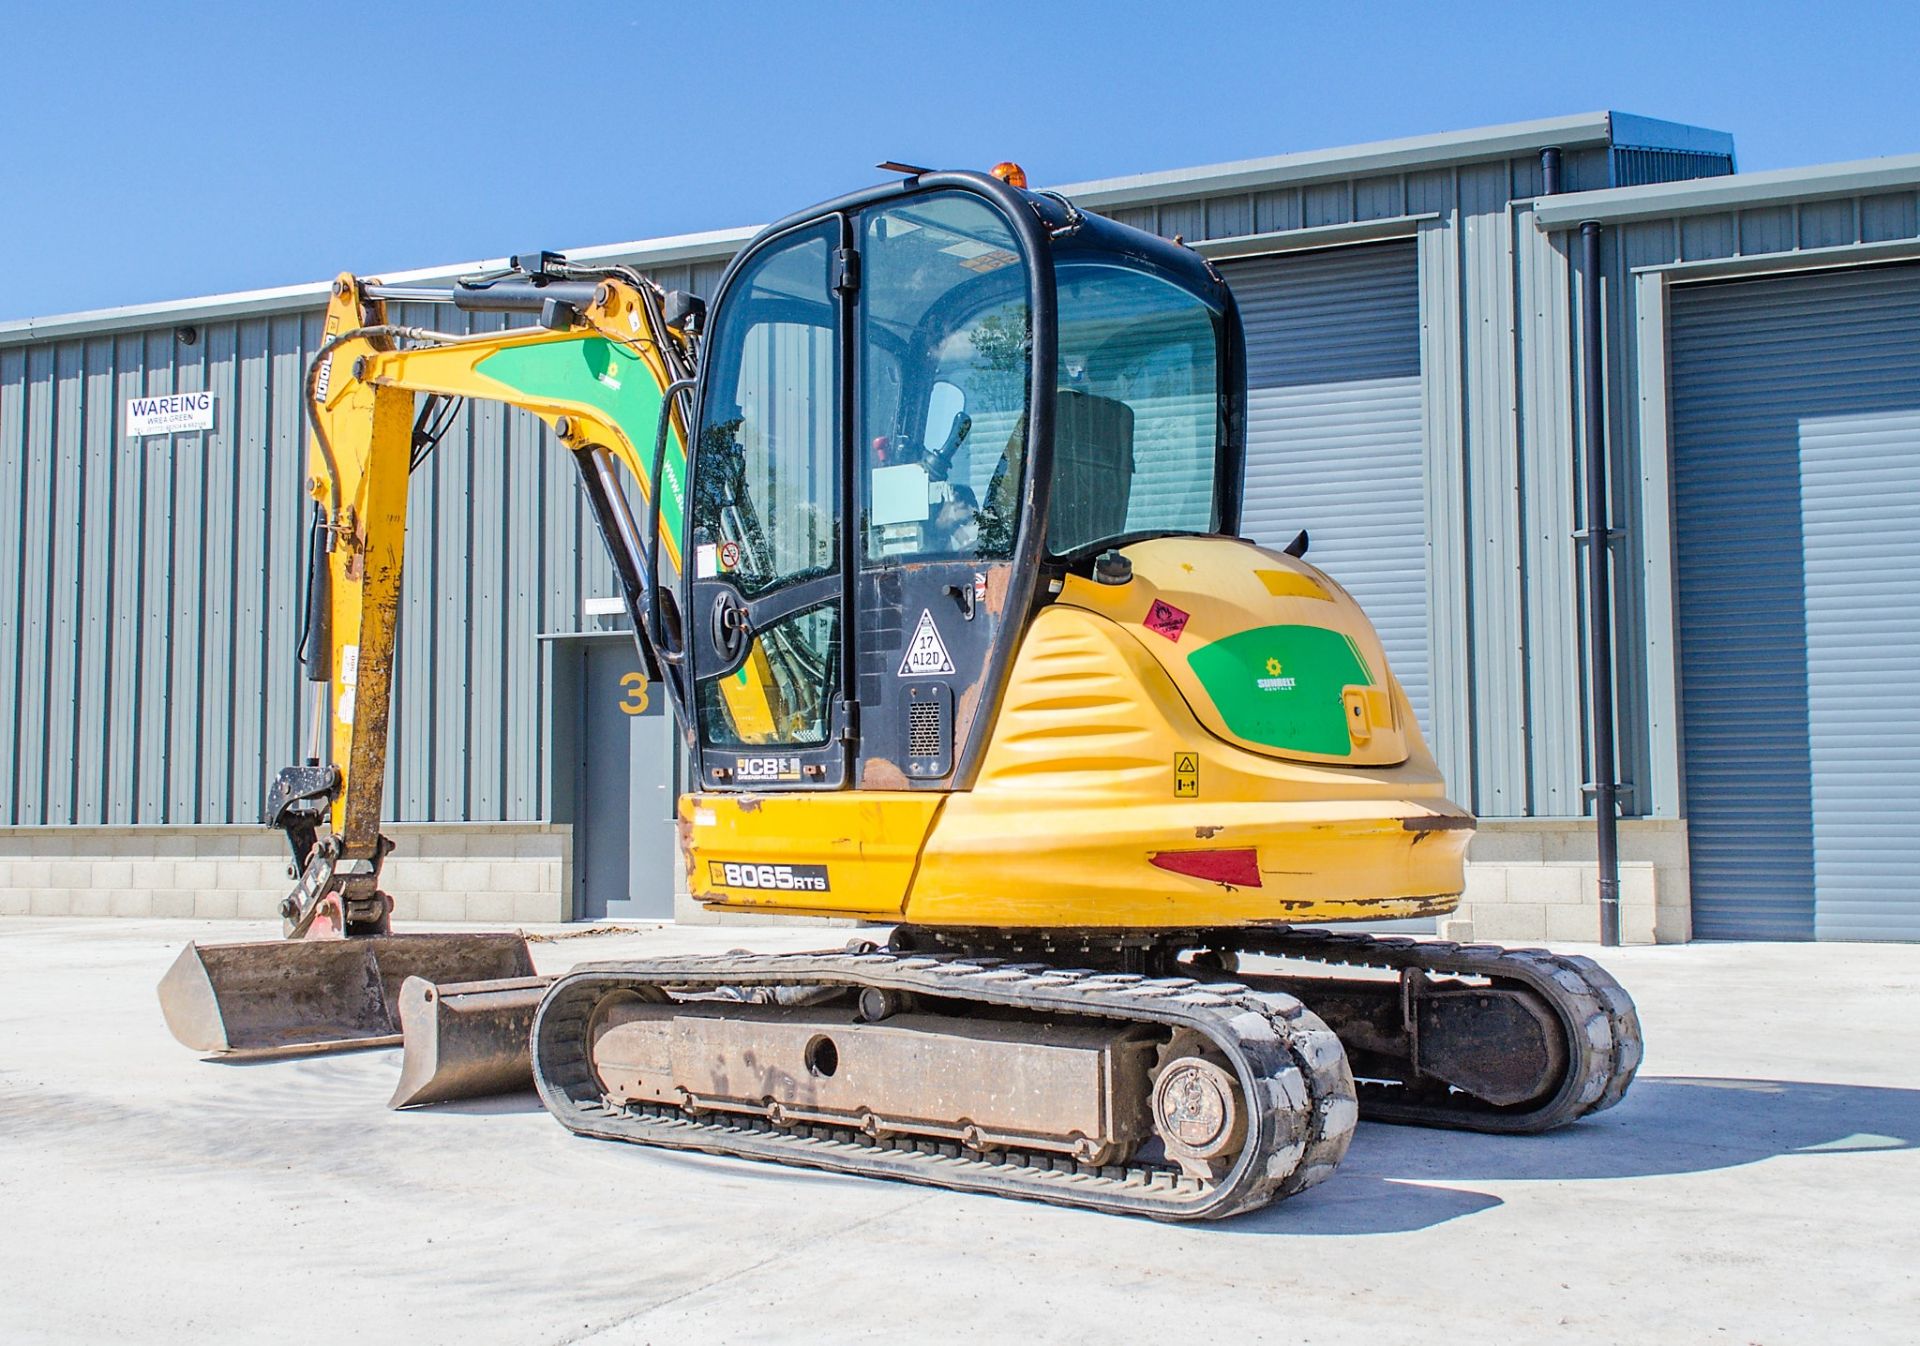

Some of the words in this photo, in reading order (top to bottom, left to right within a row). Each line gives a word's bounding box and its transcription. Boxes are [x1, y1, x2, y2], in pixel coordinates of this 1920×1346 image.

[132, 394, 209, 416] WAREING
[169, 413, 194, 423] GREEN
[919, 635, 934, 650] 17
[619, 671, 649, 715] 3
[737, 758, 778, 775] JCB
